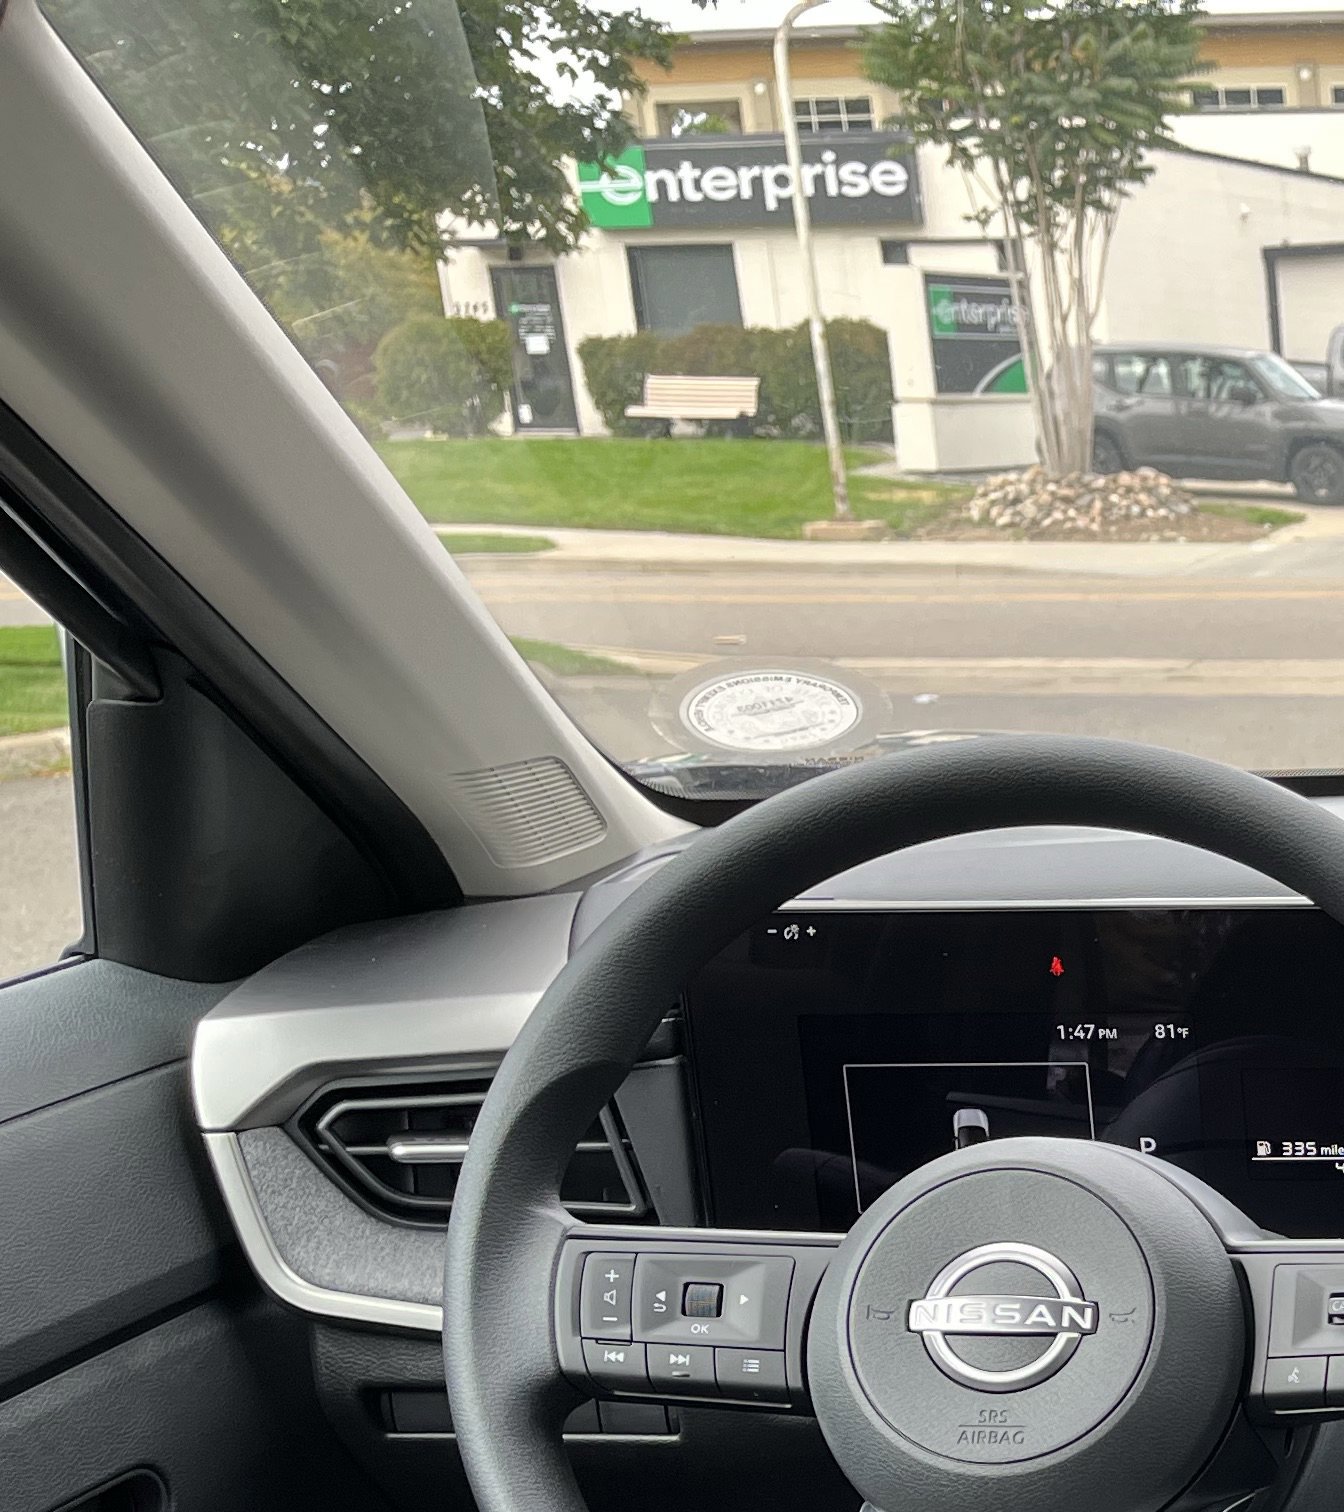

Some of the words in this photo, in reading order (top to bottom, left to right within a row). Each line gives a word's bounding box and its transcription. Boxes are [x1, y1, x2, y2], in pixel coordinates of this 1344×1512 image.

[600, 150, 908, 211] enterprise
[1056, 1024, 1095, 1040] 1:47
[1098, 1028, 1118, 1039] PM
[1139, 1137, 1157, 1153] P
[1282, 1141, 1317, 1156] 335
[915, 1302, 1093, 1329] NISSAN
[691, 1324, 710, 1335] OK
[978, 1409, 1008, 1424] SRS
[957, 1430, 1025, 1445] AIRBAG
